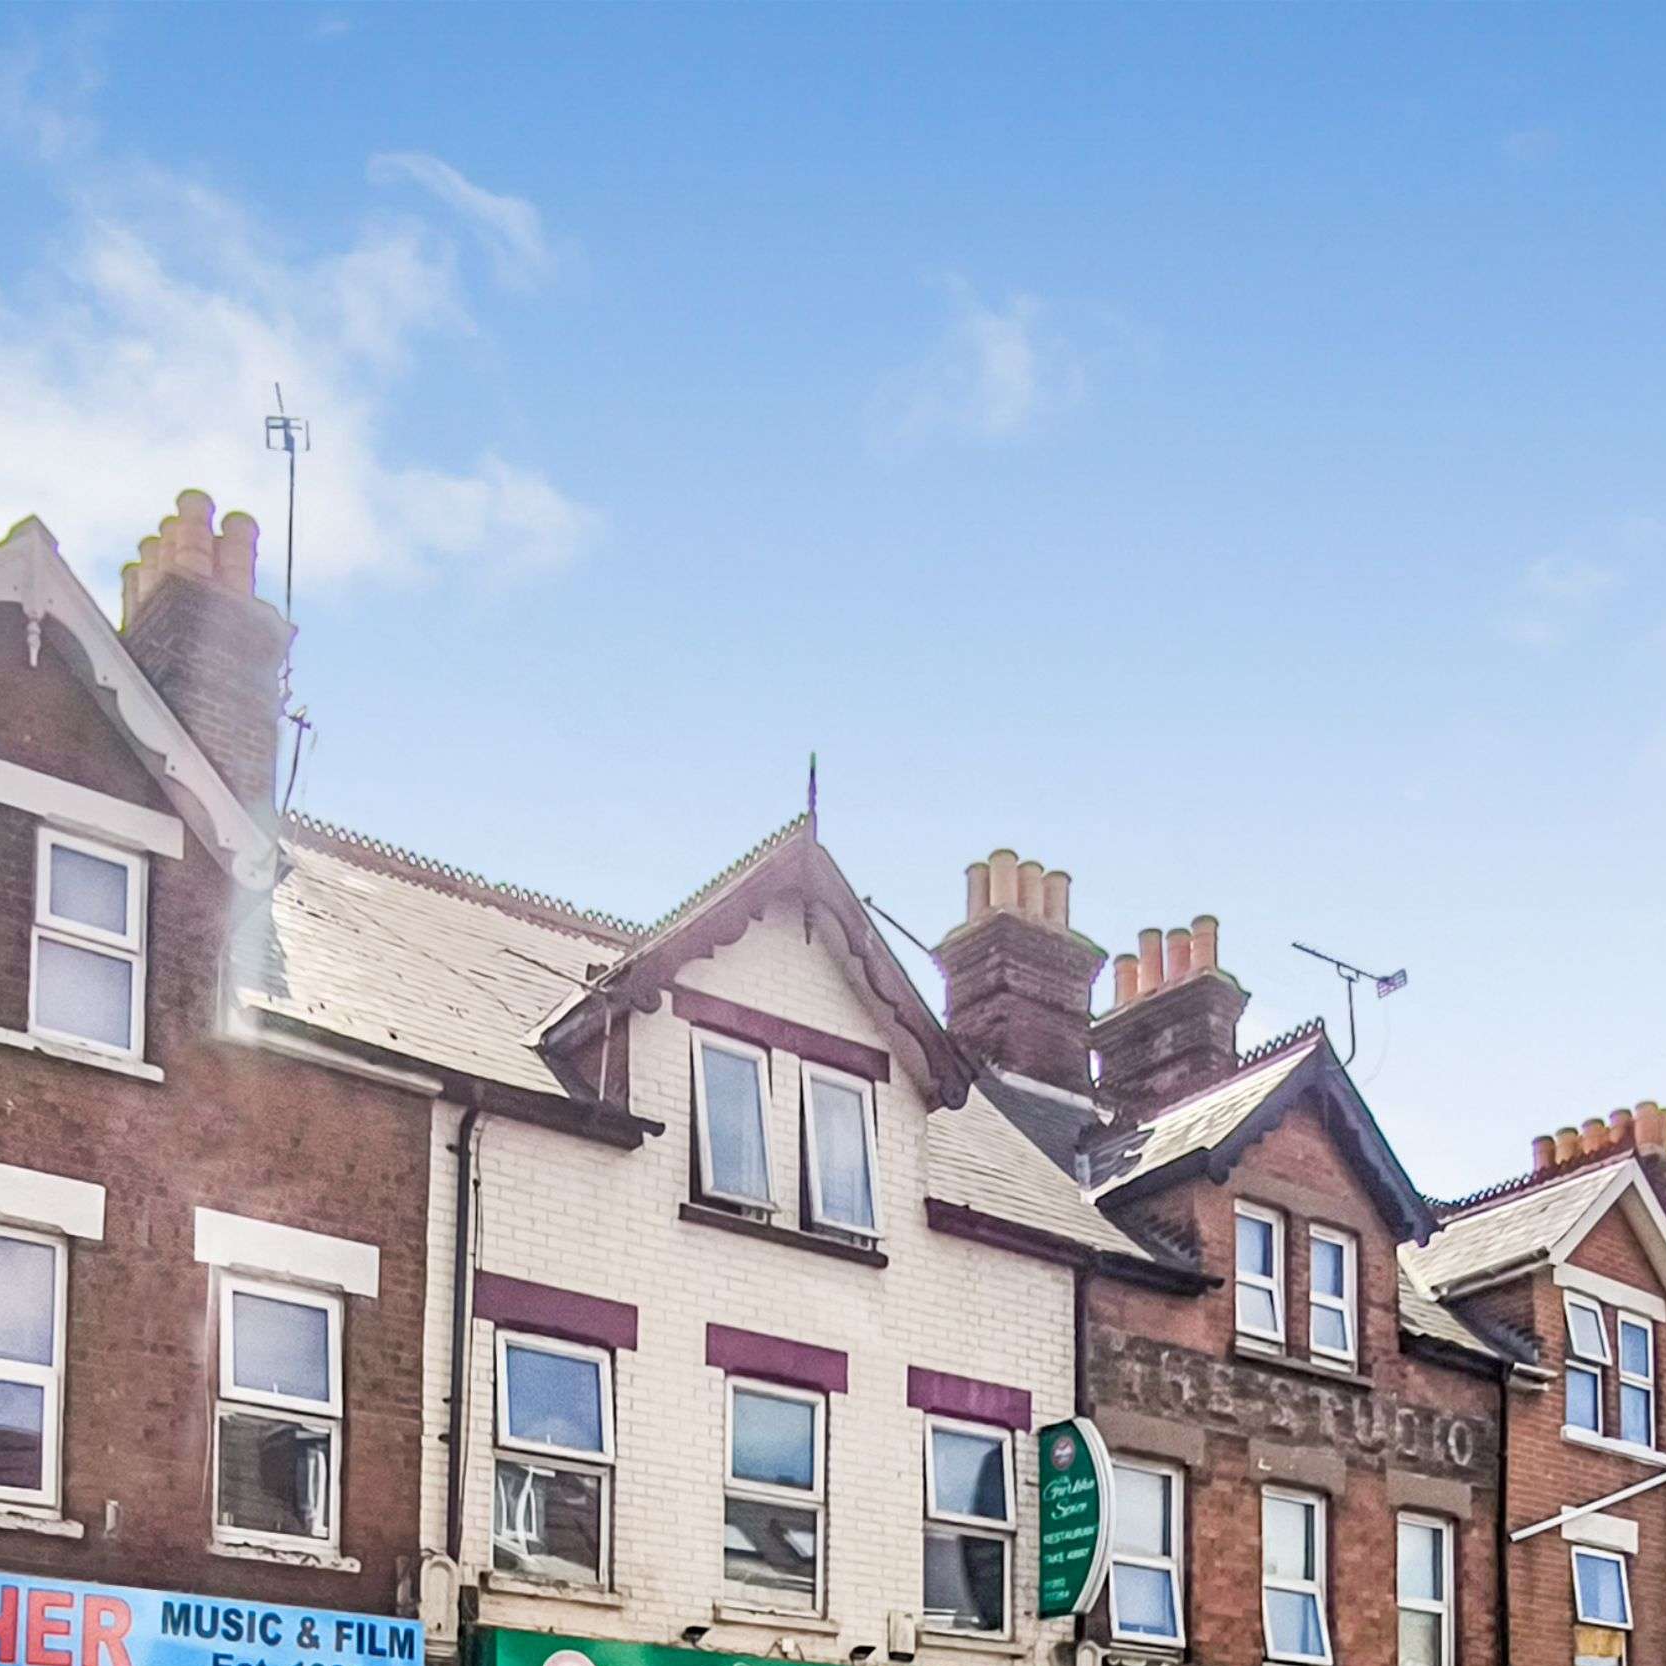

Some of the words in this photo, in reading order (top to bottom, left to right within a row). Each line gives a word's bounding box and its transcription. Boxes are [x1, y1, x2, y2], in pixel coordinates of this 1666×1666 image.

[161, 1601, 283, 1647] MUSIC
[296, 1616, 321, 1650] &
[335, 1620, 415, 1661] FILM
